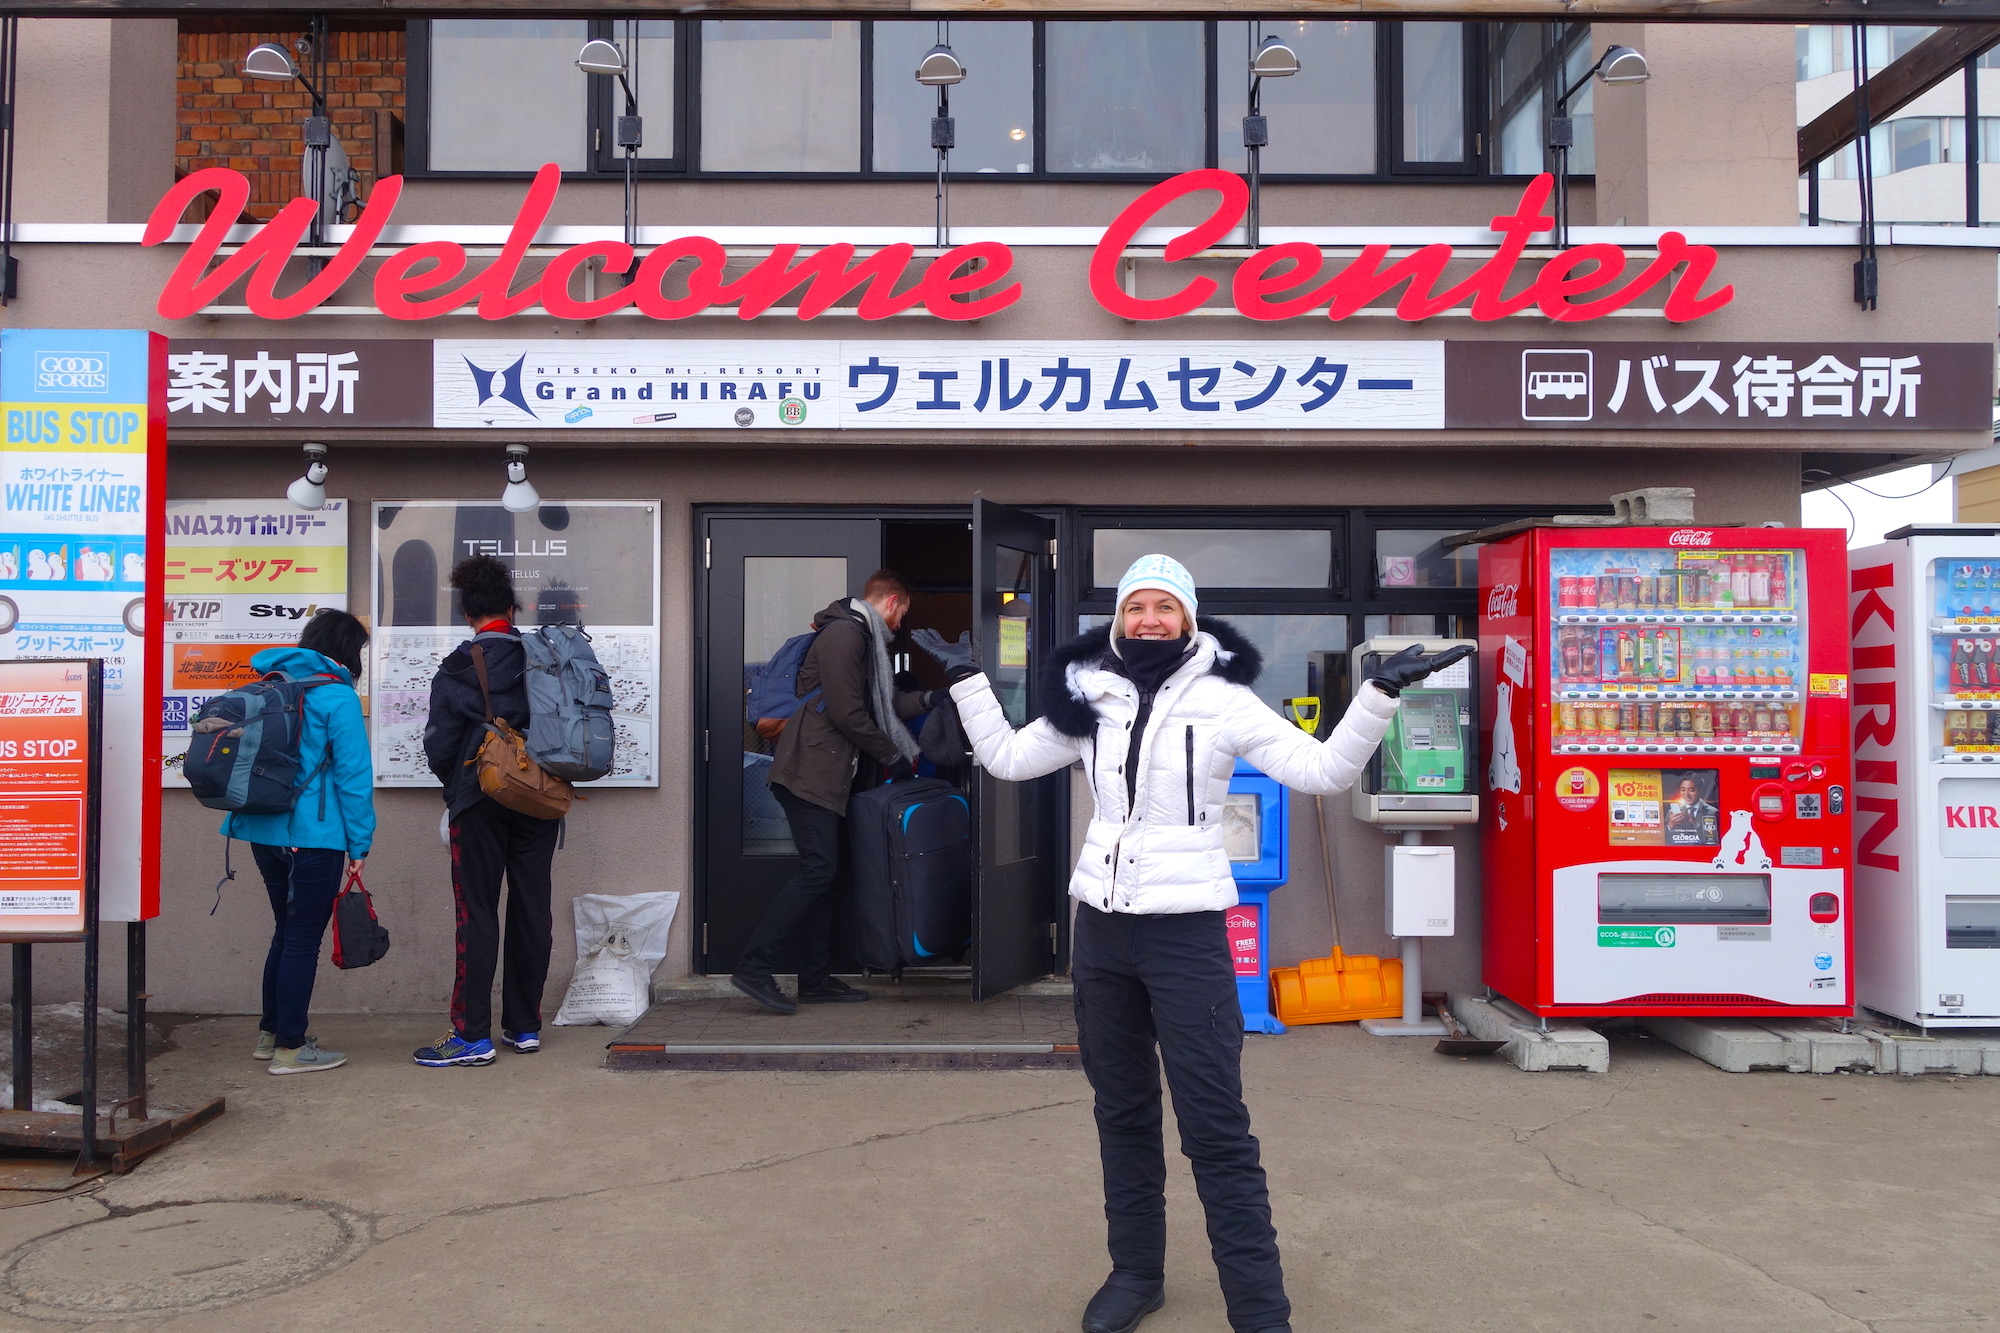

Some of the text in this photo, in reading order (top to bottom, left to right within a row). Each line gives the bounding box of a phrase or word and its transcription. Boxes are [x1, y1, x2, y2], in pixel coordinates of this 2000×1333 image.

[142, 162, 1734, 322] Welcome Center
[41, 357, 104, 374] GOOD
[537, 367, 637, 375] NISEKO
[38, 373, 106, 388] SPORTS
[167, 350, 359, 414] 案内所
[848, 356, 1413, 413] ウェルカムセンター
[1607, 355, 1922, 418] バス待合所
[785, 407, 800, 416] BB
[7, 410, 140, 445] BUS STOP
[20, 467, 124, 482] ホワイトライナー
[5, 484, 141, 512] WHITE LINER
[1668, 530, 1714, 546] Coca-Cola
[463, 539, 567, 556] TELLUS
[165, 558, 318, 582] ニーズツアー
[511, 569, 540, 579] TELLUS
[1487, 583, 1519, 620] Coca-Cola
[16, 635, 125, 652] グッドスポーツ
[20, 707, 51, 715] RESORT
[1851, 562, 1899, 873] KIRIN
[23, 740, 77, 758] STOP
[1235, 937, 1256, 947] FREE!
